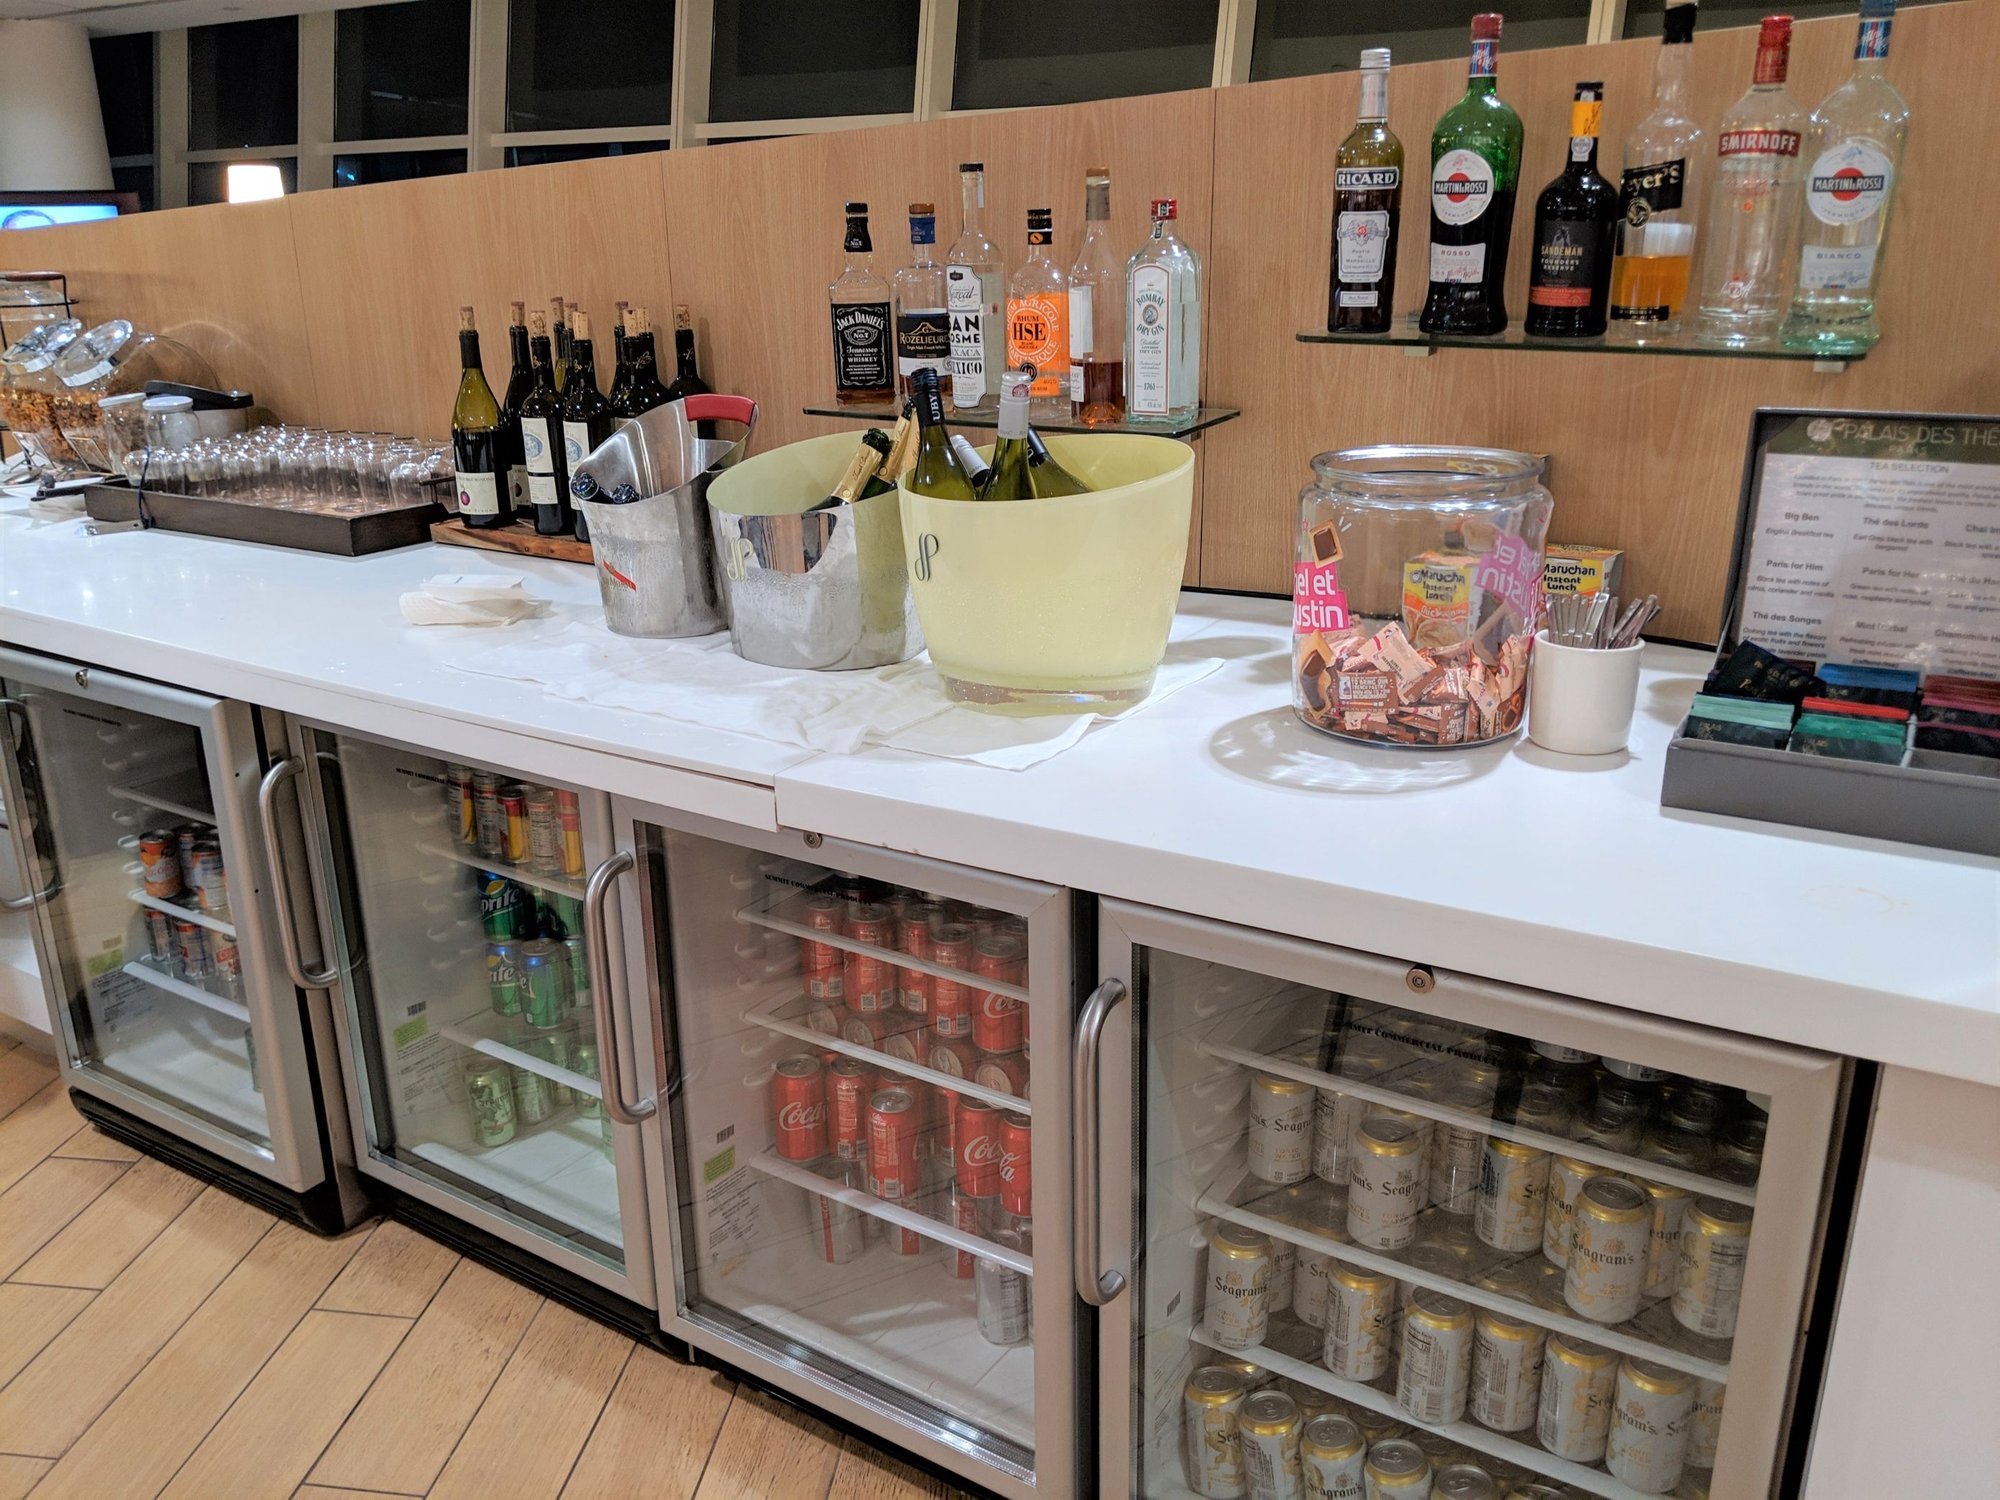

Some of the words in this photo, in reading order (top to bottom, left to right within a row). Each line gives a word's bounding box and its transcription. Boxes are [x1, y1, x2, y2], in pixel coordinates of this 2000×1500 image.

[1721, 133, 1796, 151] SMIRNOFF
[1338, 172, 1394, 186] RICARD
[1541, 246, 1582, 256] SANDEMAN
[1136, 293, 1165, 307] BOMBAY
[837, 314, 856, 331] JACK
[1020, 299, 1060, 332] AGRICOLE
[950, 315, 980, 332] AN
[1136, 323, 1150, 336] DRY
[1151, 324, 1165, 336] GIN
[900, 332, 950, 344] ROZELIEURE
[950, 334, 980, 344] OSME
[1013, 323, 1046, 341] HSE
[1008, 340, 1057, 363] MARTINIQUE
[1144, 383, 1155, 391] 1761
[928, 393, 941, 421] UBY
[1843, 425, 1910, 443] PALAIS
[1916, 426, 1956, 444] DES
[1870, 462, 1890, 471] TEA
[1892, 463, 1949, 473] SELECTION
[1785, 512, 1799, 522] Big
[1802, 513, 1819, 521] Ben
[1882, 518, 1899, 527] des
[1901, 520, 1929, 528] Lords
[1766, 560, 1788, 568] Paris
[1791, 561, 1804, 570] for
[1805, 563, 1823, 571] Him
[1862, 567, 1886, 576] Paris
[1313, 569, 1335, 596] et
[1543, 575, 1582, 584] Instant
[1547, 583, 1576, 592] Lunch
[1753, 611, 1768, 619] Thé
[1770, 613, 1786, 621] des
[1788, 615, 1822, 625] Songes
[765, 874, 789, 885] SUMMIT
[1375, 1027, 1444, 1053] COMMERCIAL
[1571, 1231, 1635, 1266] Seagram's
[1307, 1480, 1363, 1499] Seagram's
